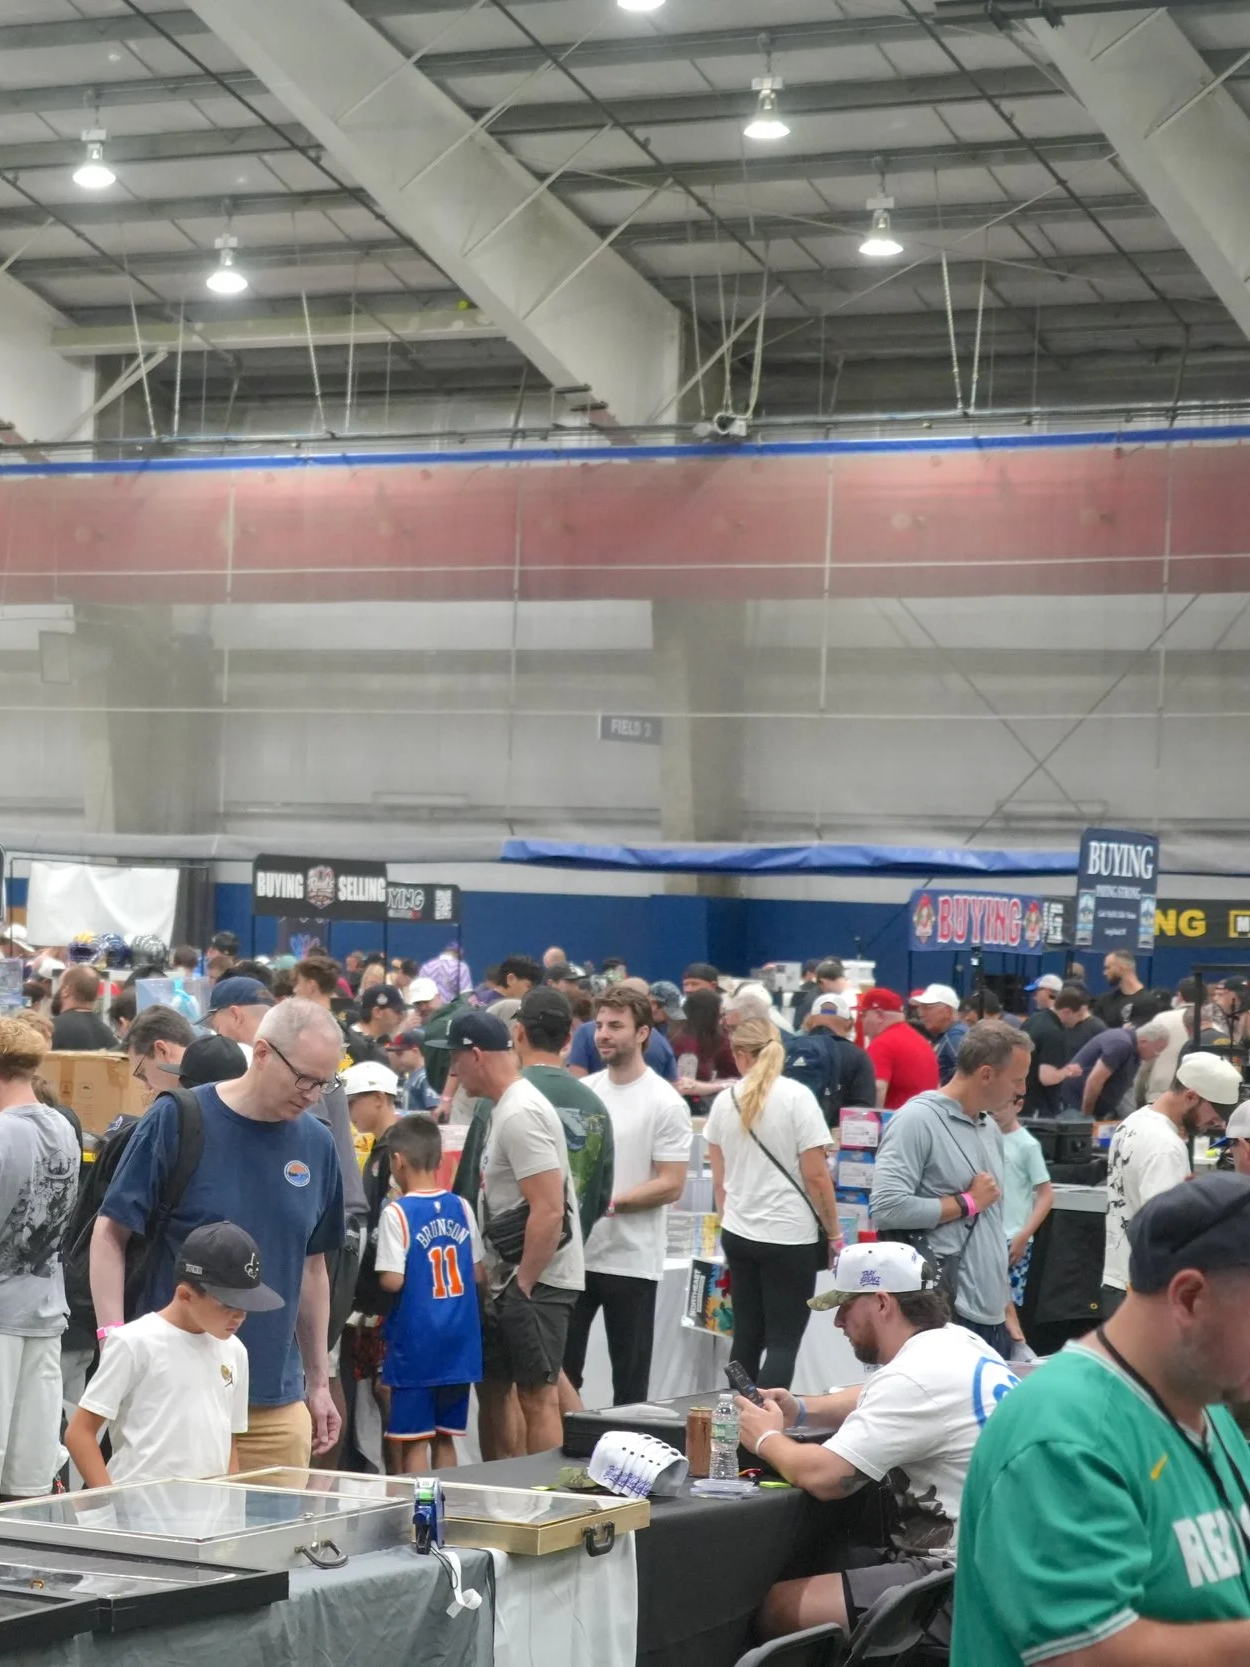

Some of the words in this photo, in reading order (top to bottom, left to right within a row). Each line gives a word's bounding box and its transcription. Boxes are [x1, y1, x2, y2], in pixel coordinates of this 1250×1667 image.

[611, 719, 641, 736] FIELD
[1087, 841, 1154, 879] BUYING
[256, 871, 304, 899] BUYING
[338, 875, 387, 902] SELLING
[937, 895, 1023, 946] BUYING
[1154, 908, 1207, 938] NG
[415, 1218, 470, 1249] BRUNSON
[428, 1244, 464, 1299] 11
